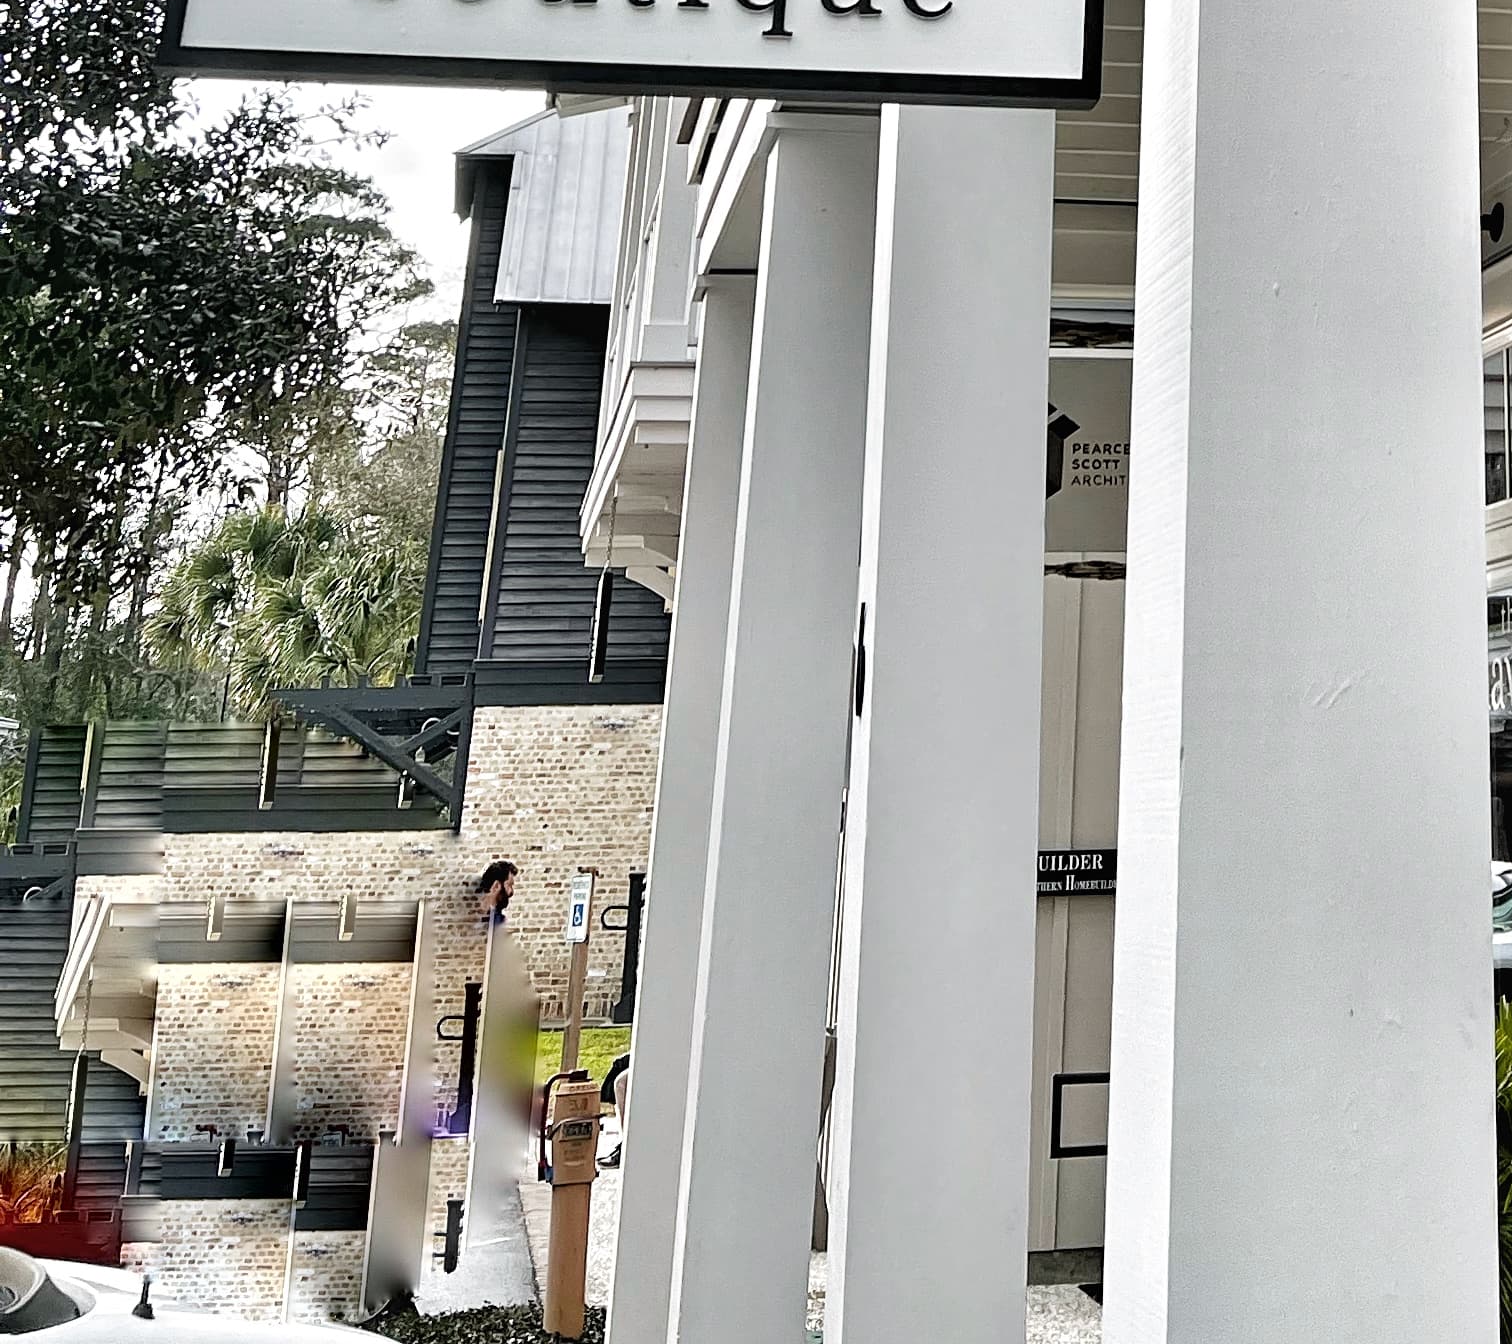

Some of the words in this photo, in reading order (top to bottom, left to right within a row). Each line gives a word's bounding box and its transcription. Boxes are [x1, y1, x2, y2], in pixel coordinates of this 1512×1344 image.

[1072, 443, 1130, 455] PEARCE
[1072, 459, 1120, 470] SCOTT
[1071, 474, 1126, 487] ARCHIT
